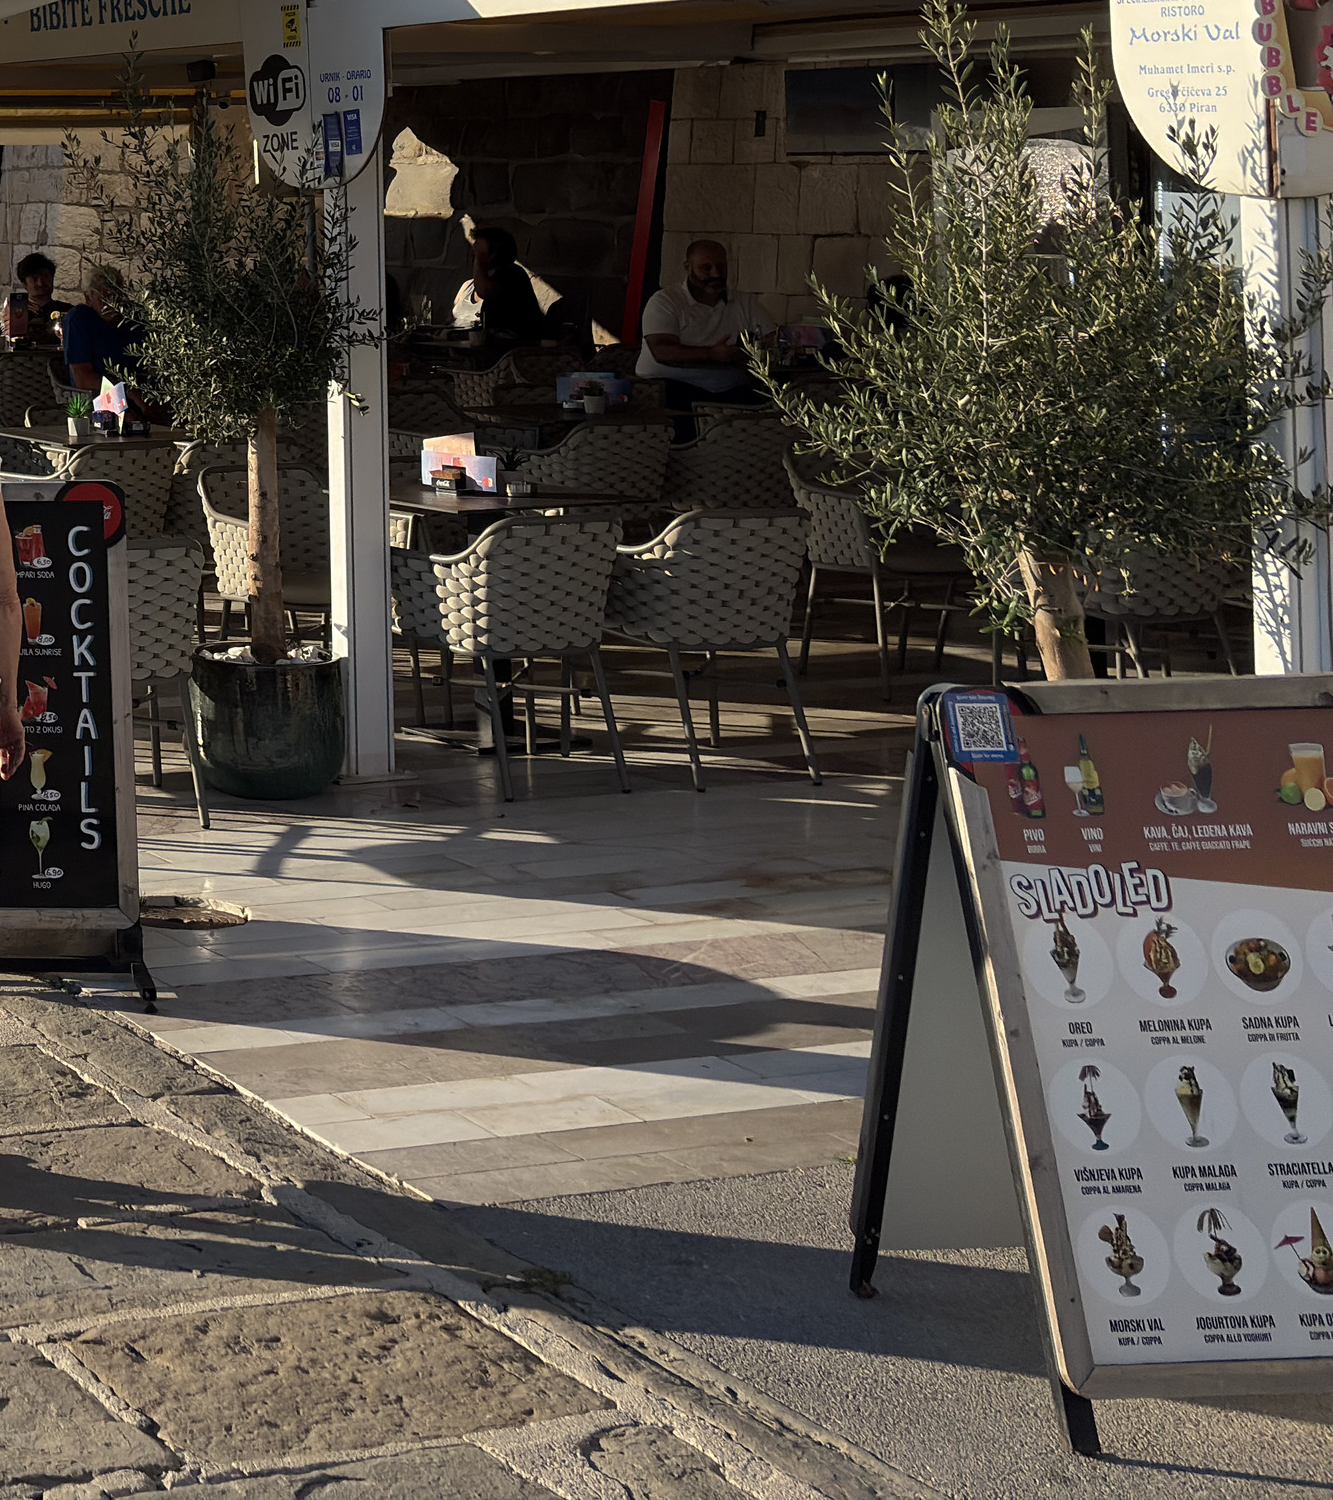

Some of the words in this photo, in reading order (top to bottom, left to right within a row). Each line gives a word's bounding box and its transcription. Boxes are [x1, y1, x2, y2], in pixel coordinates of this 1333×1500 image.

[1160, 5, 1205, 17] RISTORO
[1129, 23, 1198, 45] Morski
[1203, 21, 1240, 41] Val
[319, 71, 340, 83] URNIK
[346, 69, 371, 80] ORARIO
[1139, 64, 1184, 75] Muhamet
[1187, 63, 1214, 74] Imeri
[327, 86, 341, 103] 08
[1215, 85, 1228, 97] 25
[1159, 103, 1186, 113] 6330
[1189, 102, 1218, 113] Piran
[263, 131, 299, 153] ZONE
[16, 571, 36, 579] MPARI
[37, 571, 55, 579] SODA
[35, 648, 62, 656] SUNRISE
[68, 526, 102, 850] COCKTAILS
[1023, 828, 1045, 841] PIVO
[1081, 827, 1103, 840] VINO
[1192, 825, 1228, 838] LEDENA
[1229, 824, 1253, 837] KAVA
[1287, 822, 1328, 835] NARAVNI
[33, 881, 51, 889] HUGO
[1010, 861, 1172, 923] SLADOLED
[1068, 1021, 1093, 1034] OREO
[1139, 1019, 1186, 1033] MELONINA
[1187, 1018, 1212, 1031] KUPA
[1242, 1016, 1274, 1029] SADNA
[1274, 1015, 1301, 1029] KUPA
[1074, 1166, 1117, 1182] VIŠNJEVA
[1118, 1167, 1143, 1181] KUPA
[1172, 1166, 1197, 1179] KUPA
[1198, 1164, 1237, 1178] MALAGA
[1109, 1318, 1146, 1333] MORSKI
[1148, 1318, 1165, 1332] VAL
[1196, 1315, 1248, 1330] JOGURTOVA
[1249, 1314, 1276, 1328] KUPA
[1299, 1313, 1325, 1327] KUPA
